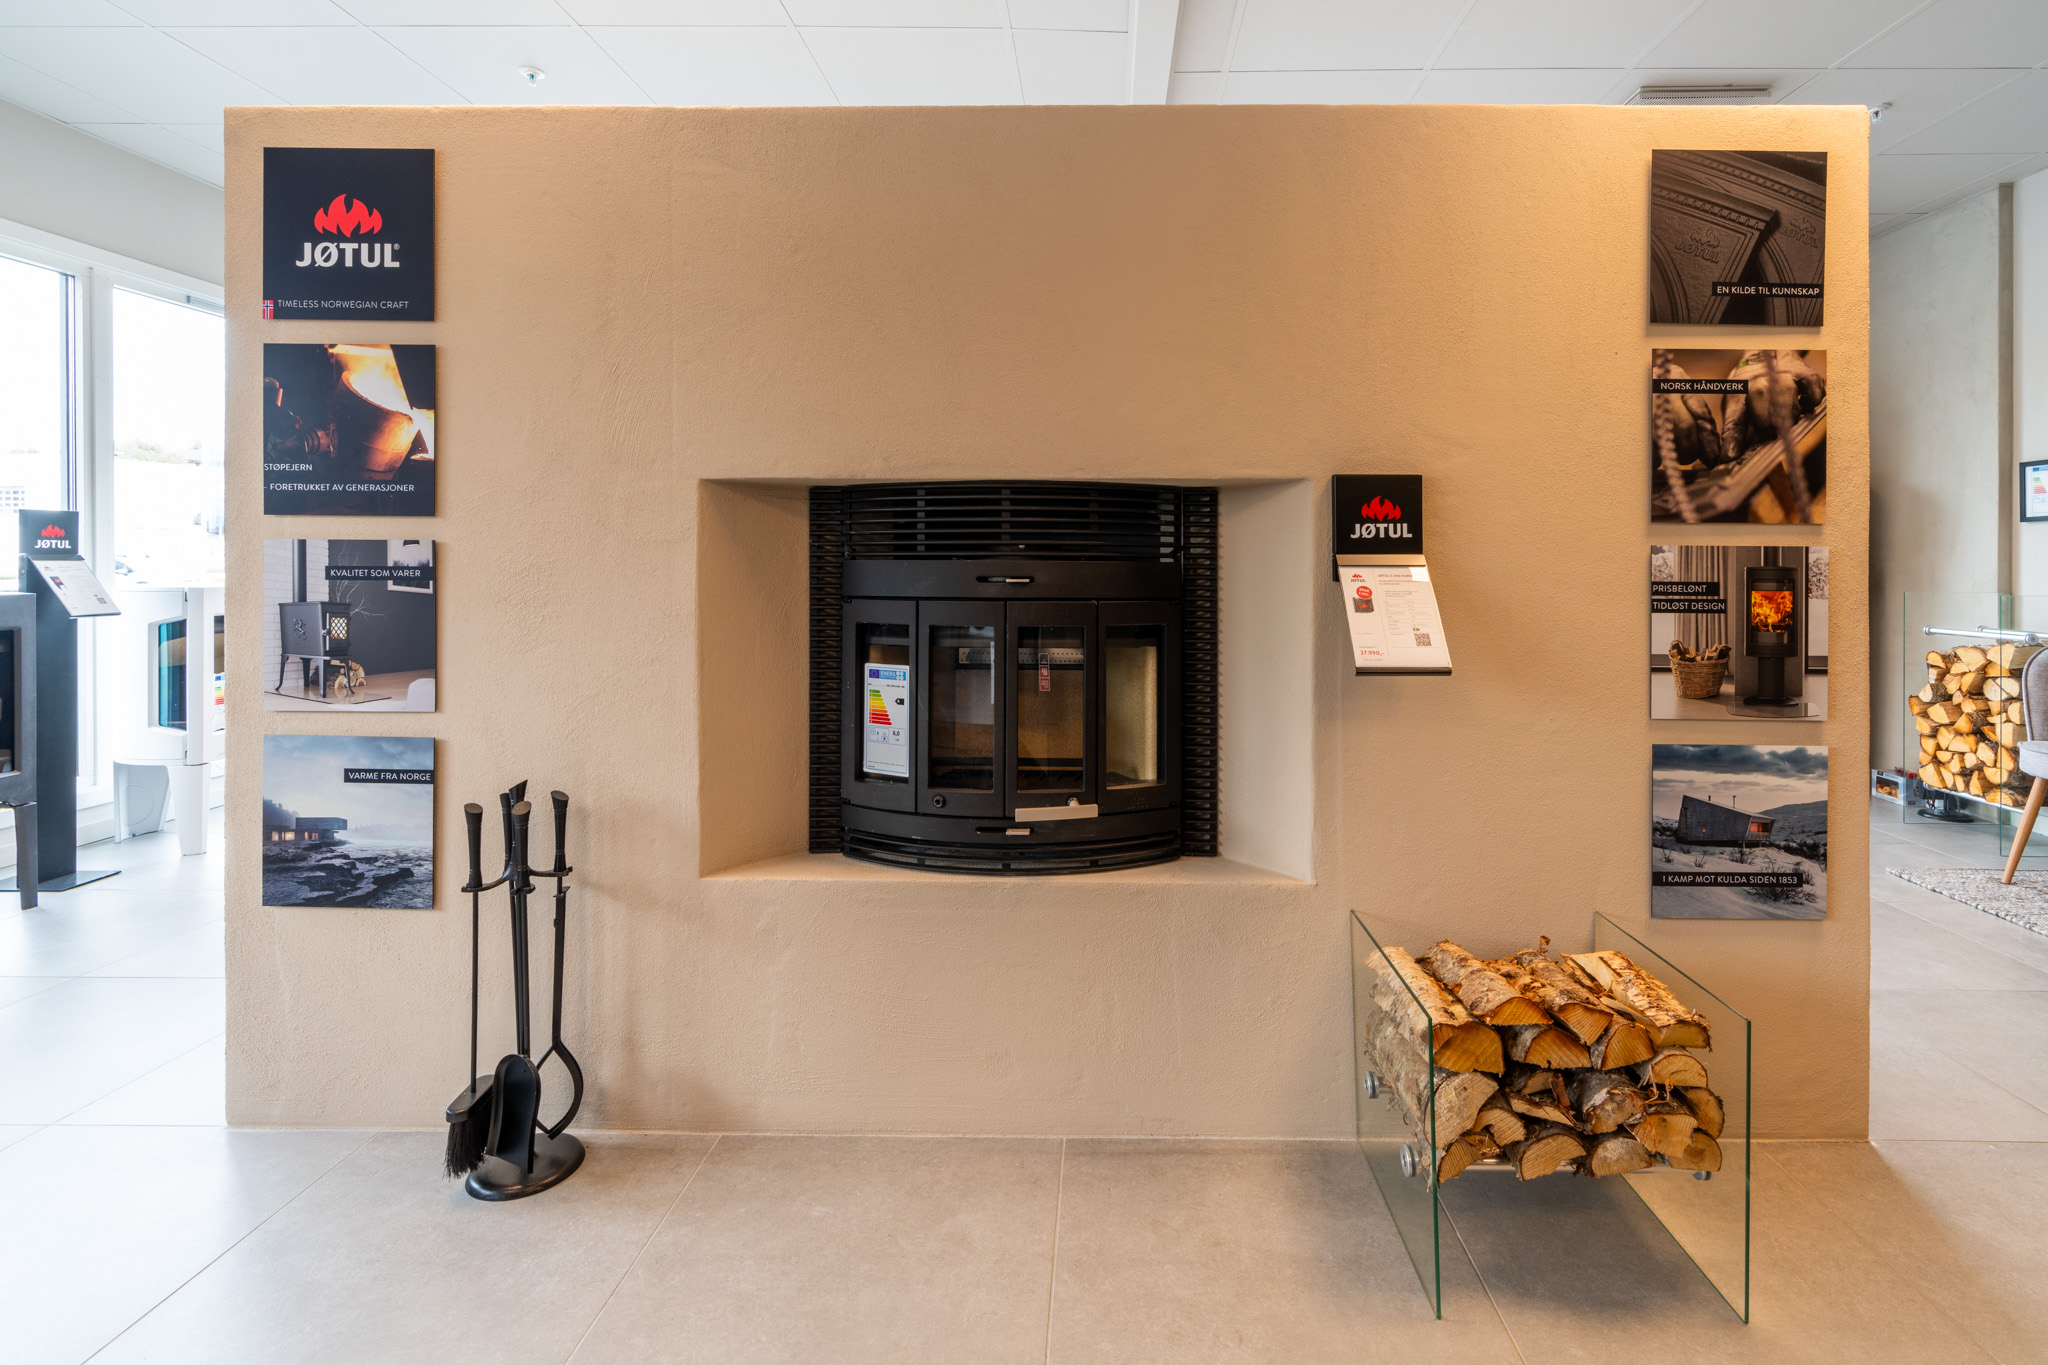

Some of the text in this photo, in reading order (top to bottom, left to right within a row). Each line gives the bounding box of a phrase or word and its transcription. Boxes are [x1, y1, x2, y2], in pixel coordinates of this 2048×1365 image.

[1717, 286, 1821, 296] EN KILDE TIL KUNNSKAP
[277, 299, 409, 310] TIMELESS NORWEGIAN CRAFT
[1660, 380, 1745, 391] NORSK HÅNDVERK
[263, 463, 313, 472] STØPEJERN
[270, 483, 331, 492] FORETRUKKET
[332, 483, 345, 492] AV
[345, 483, 415, 492] GENERASJONER
[1350, 523, 1412, 538] JØTUL
[34, 540, 71, 548] JØTUL
[330, 569, 421, 578] KVALITET SOM VARER
[1652, 584, 1707, 594] PRISBELØNT
[1653, 601, 1726, 611] TIDLØST DESIGN
[348, 772, 432, 782] VARME FRA NORGE
[1667, 875, 1694, 884] KAMP
[1695, 875, 1715, 884] MOT
[1717, 875, 1748, 884] KULDA
[1749, 876, 1777, 885] SIDEN
[1778, 876, 1798, 885] 1853
